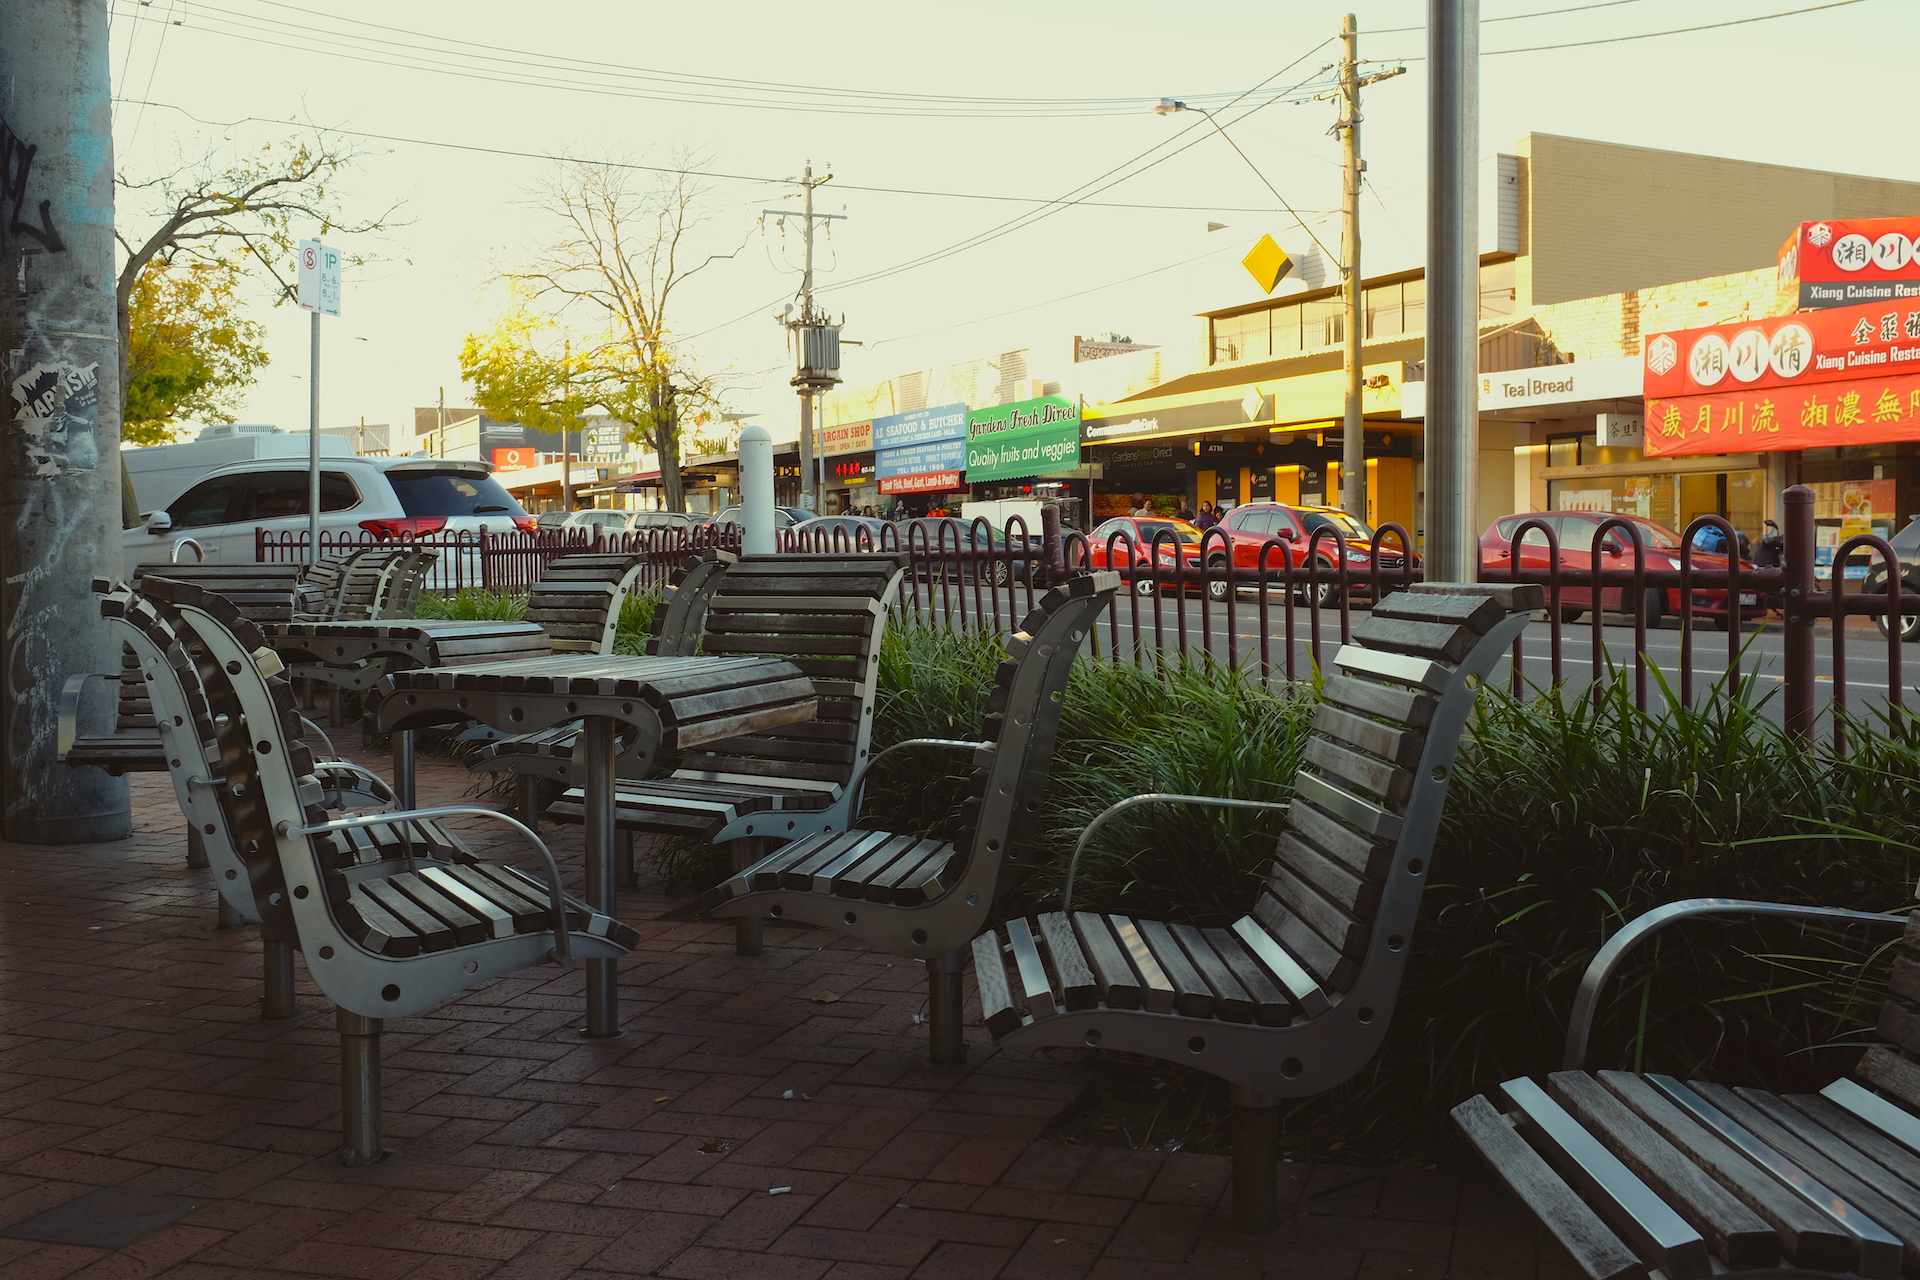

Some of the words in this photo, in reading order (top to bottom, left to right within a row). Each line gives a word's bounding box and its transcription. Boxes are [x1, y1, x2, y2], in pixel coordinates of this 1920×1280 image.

[325, 253, 337, 269] 1P
[1810, 286, 1844, 301] Xiang
[1847, 285, 1892, 298] Cuisine
[1694, 328, 1806, 377] 湘川情
[1816, 353, 1845, 371] Xiang
[1847, 347, 1887, 367] Cuisine
[851, 424, 871, 438] SHOP
[875, 428, 884, 439] AZ
[886, 422, 918, 437] SEAFOOD
[920, 420, 927, 431] &
[929, 413, 964, 430] BUTCHER
[969, 415, 1007, 442] Gardens
[1010, 406, 1039, 430] Fresh
[1042, 402, 1077, 425] Direct
[839, 442, 850, 451] OPEN
[855, 440, 867, 448] DAYS
[969, 447, 999, 470] Quality
[1000, 444, 1020, 463] fruits
[1022, 439, 1040, 460] and
[1041, 438, 1076, 462] veggies
